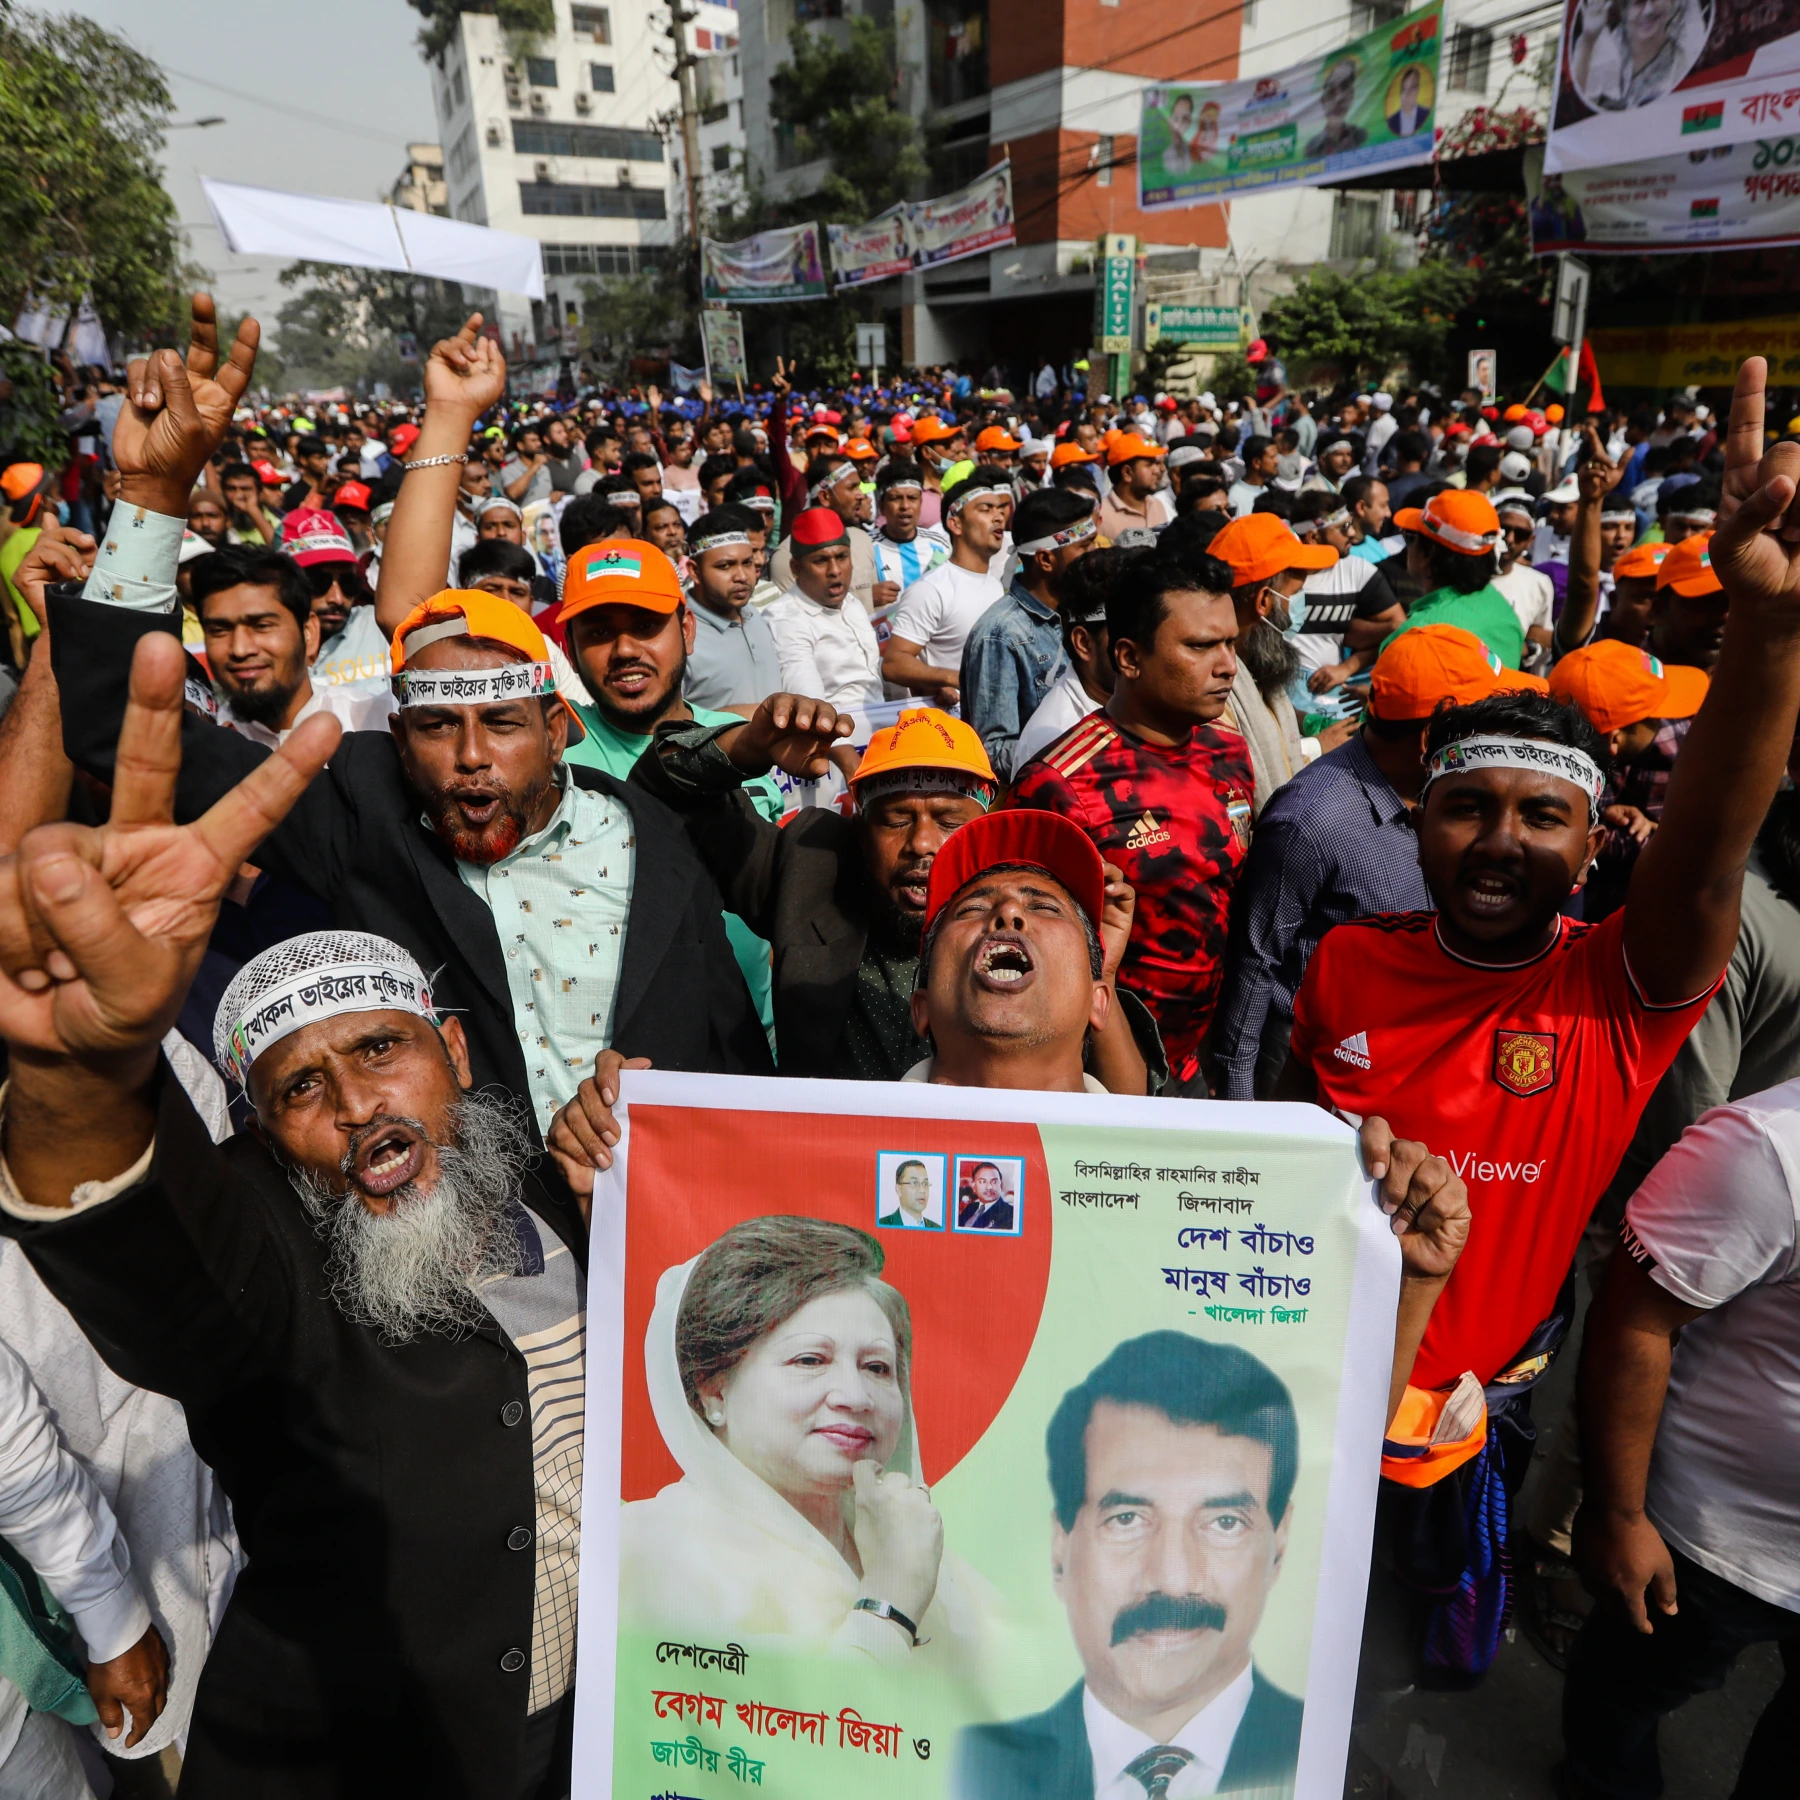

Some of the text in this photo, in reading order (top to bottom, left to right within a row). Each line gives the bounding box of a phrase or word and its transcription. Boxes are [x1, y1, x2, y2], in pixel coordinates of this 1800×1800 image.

[1111, 257, 1129, 334] QUALITY
[440, 675, 488, 699] ভাইয়ের
[491, 670, 515, 699] মুক্তি
[516, 669, 530, 690] চাই
[1462, 744, 1508, 760] খোকন
[1508, 742, 1562, 770] ভাইয়ের
[1561, 754, 1583, 781] মুক্তি
[1126, 831, 1170, 849] adidas
[243, 971, 420, 1046] খোকন ভাইয়ের মুক্তি চাই
[1333, 1048, 1371, 1070] adidas
[1505, 1038, 1545, 1057] MANCHESTER
[1510, 1073, 1537, 1083] UNITED
[1074, 1160, 1261, 1186] বিসমিল্লাহির রাহমানির রাহীম
[1430, 1150, 1546, 1183] Viewer
[1059, 1190, 1255, 1215] বাংলাদেশ জিন্দাবাদ
[1177, 1223, 1314, 1257] দেশ বাঁচাও
[1161, 1266, 1311, 1299] মানুষ বাঁচাও
[1204, 1304, 1265, 1325] খালেদা
[1270, 1305, 1308, 1324] জিয়া
[656, 1641, 749, 1676] দেশনেত্রী
[651, 1690, 931, 1761] বেগম খালেদা জিয়া ও
[650, 1735, 766, 1786] জাতীয় বীর
